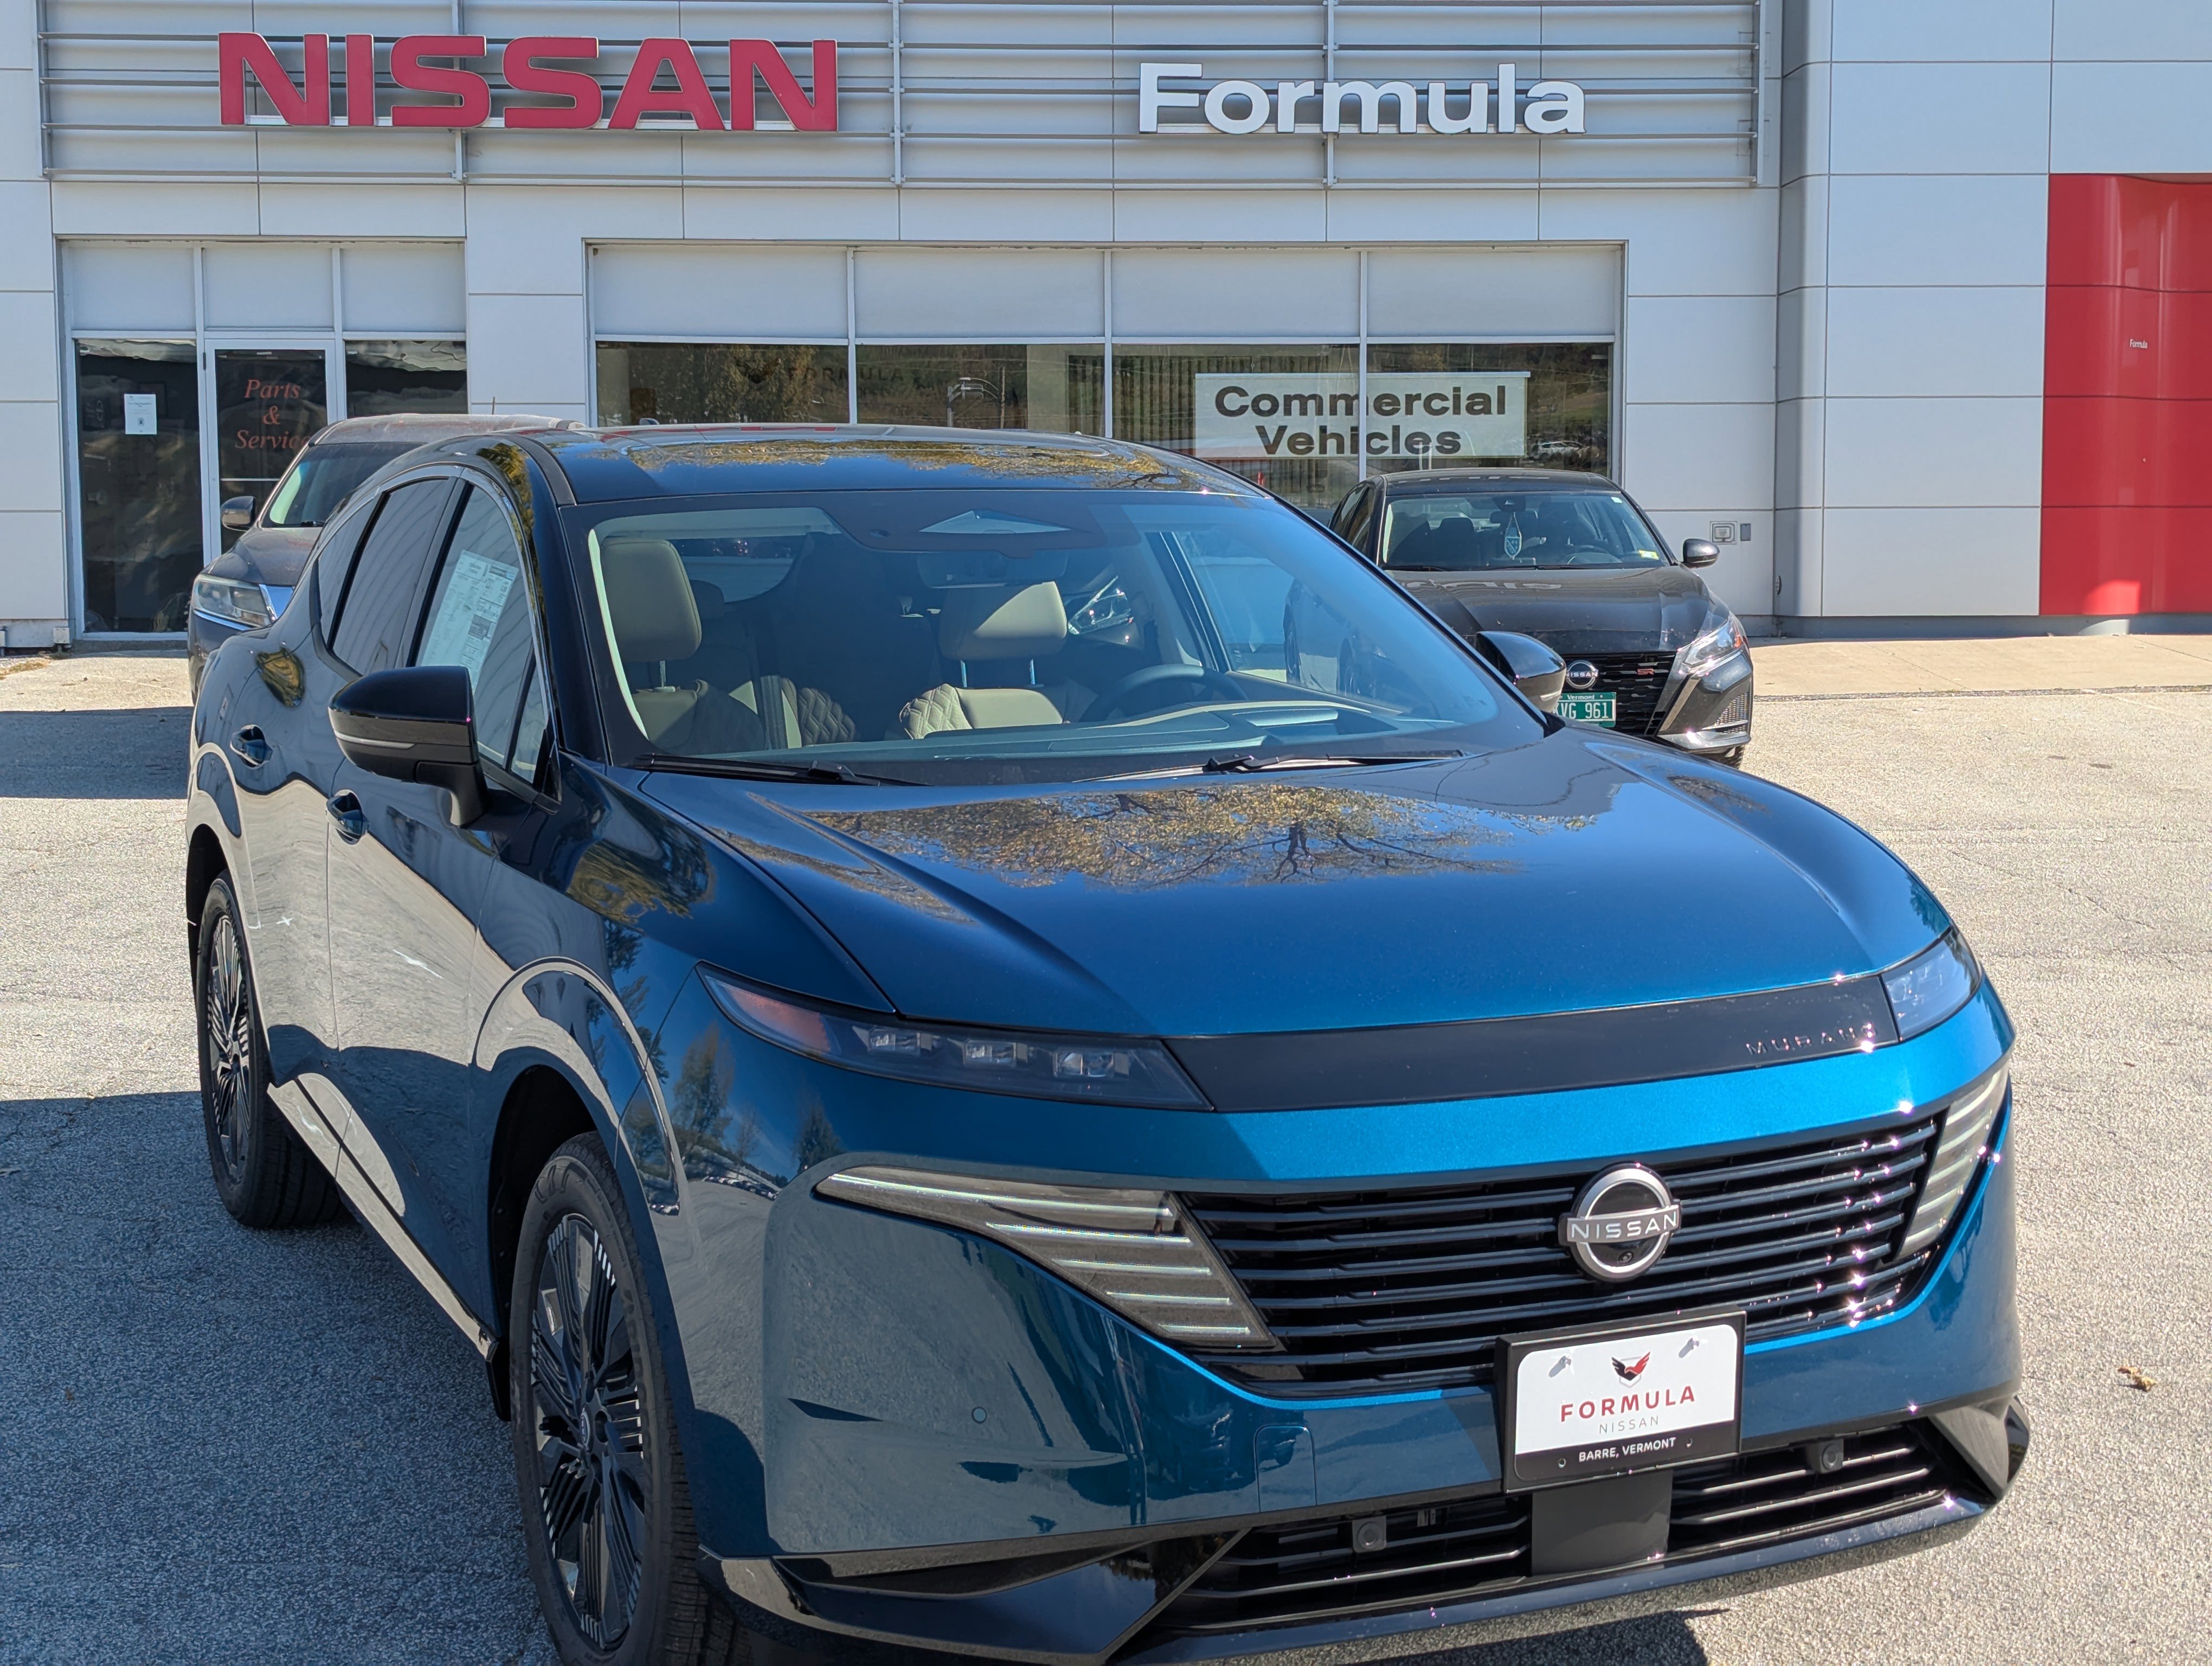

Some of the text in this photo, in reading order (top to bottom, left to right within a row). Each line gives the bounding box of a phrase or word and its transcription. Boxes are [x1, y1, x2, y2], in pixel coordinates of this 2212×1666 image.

[218, 31, 838, 132] NISSAN
[1139, 62, 1586, 134] Formula
[2130, 339, 2147, 348] Formula
[244, 379, 301, 399] Parts
[1214, 385, 1506, 417] Commercial
[262, 406, 281, 425] &
[1255, 425, 1462, 456] Vehicles
[1585, 702, 1609, 719] 961
[1571, 1211, 1676, 1239] NISSAN
[1560, 1386, 1695, 1422] FORMULA
[1599, 1415, 1659, 1434] NISSAN
[1579, 1437, 1677, 1462] BARRE, VERMONT
